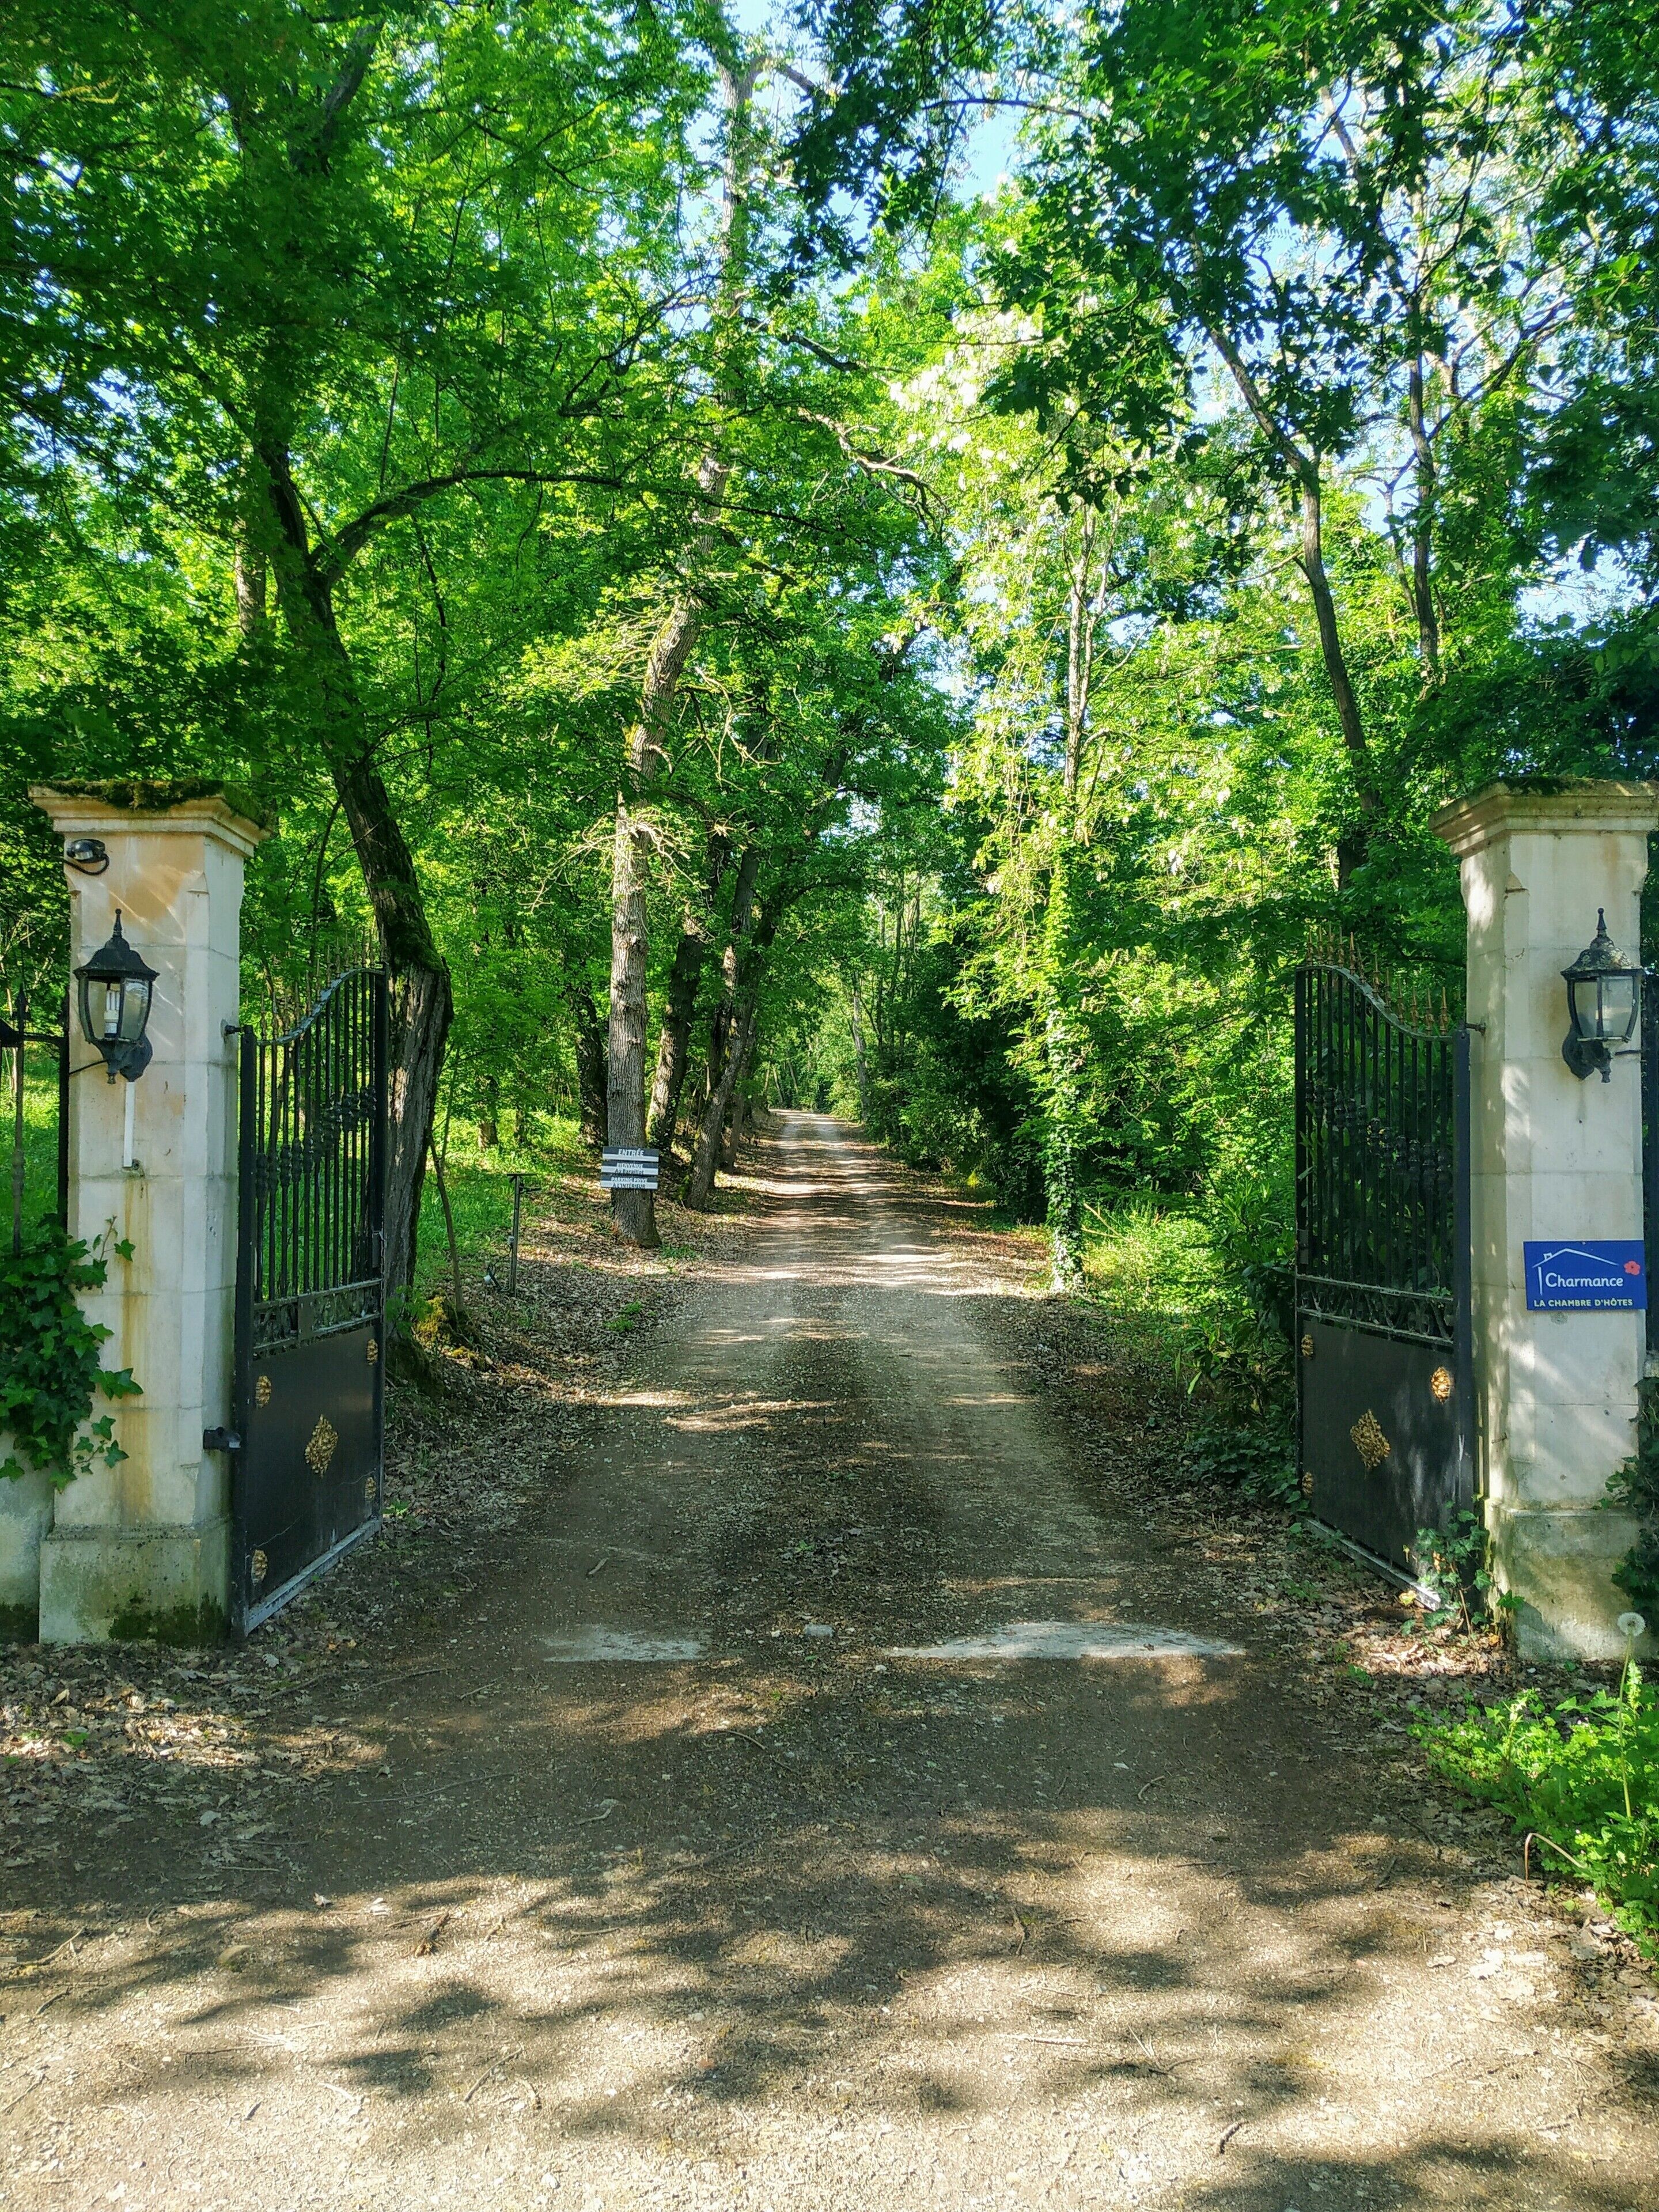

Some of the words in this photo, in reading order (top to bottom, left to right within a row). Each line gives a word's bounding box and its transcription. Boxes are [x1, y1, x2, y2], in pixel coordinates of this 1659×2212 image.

[618, 1148, 644, 1156] ENTRÉE
[1545, 1272, 1623, 1287] Charmance
[1595, 1297, 1633, 1306] D'HÔTES
